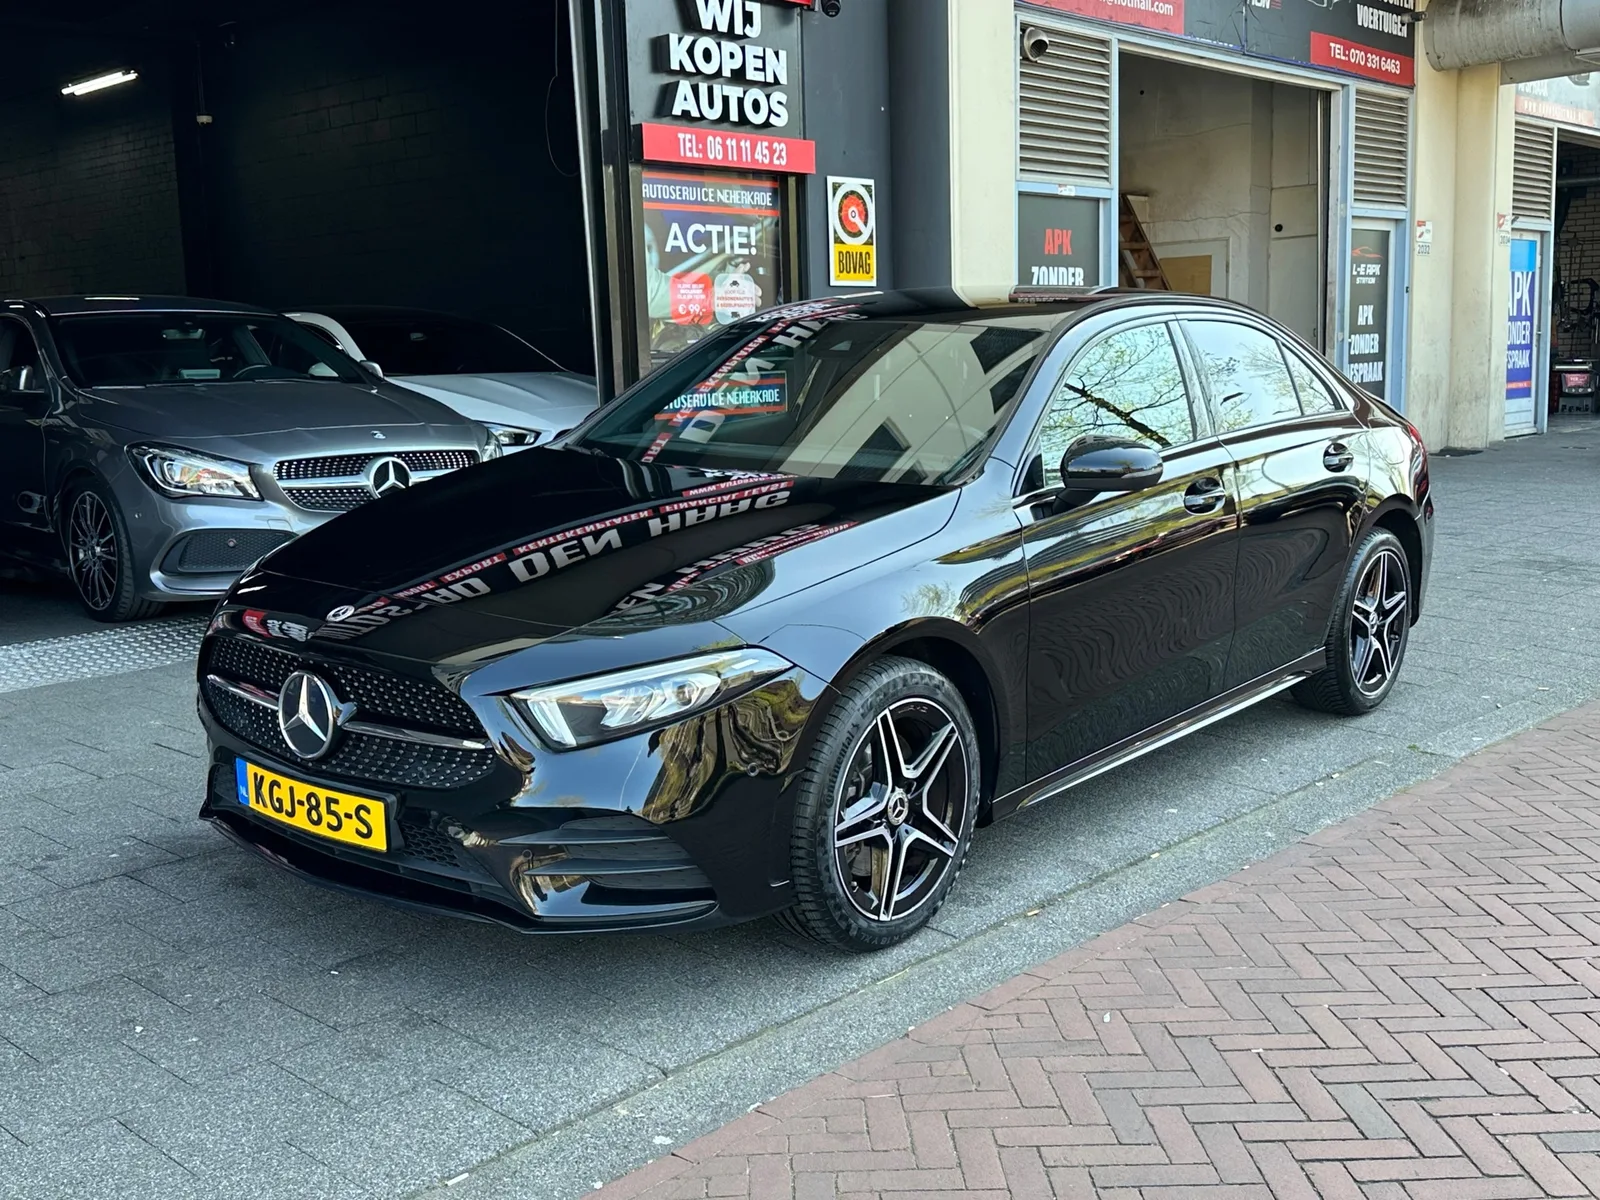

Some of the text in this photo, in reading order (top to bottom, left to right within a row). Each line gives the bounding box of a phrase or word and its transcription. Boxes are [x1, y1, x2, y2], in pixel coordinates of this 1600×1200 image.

[696, 0, 762, 38] WIJ
[1356, 3, 1408, 38] VOERTUIGEN
[668, 32, 788, 85] KOPEN
[1329, 42, 1401, 75] TEL: 070 331 6463
[671, 79, 789, 128] AUTOS
[677, 132, 787, 166] TEL: 06 11 11 45 23
[716, 188, 773, 207] NEHERKADE
[664, 222, 757, 256] ACTIE!
[1044, 228, 1073, 256] APK
[1417, 244, 1430, 255] 2032
[838, 251, 871, 276] BOVAG
[1031, 265, 1085, 287] ZONDER
[1365, 264, 1381, 276] APK
[678, 303, 687, 315] €
[1357, 304, 1374, 326] APK
[1350, 333, 1380, 355] ZONDER
[1507, 320, 1531, 346] ONDER
[1349, 361, 1384, 385] FSPRAAK
[239, 771, 374, 840] NL KGJ-85-S
